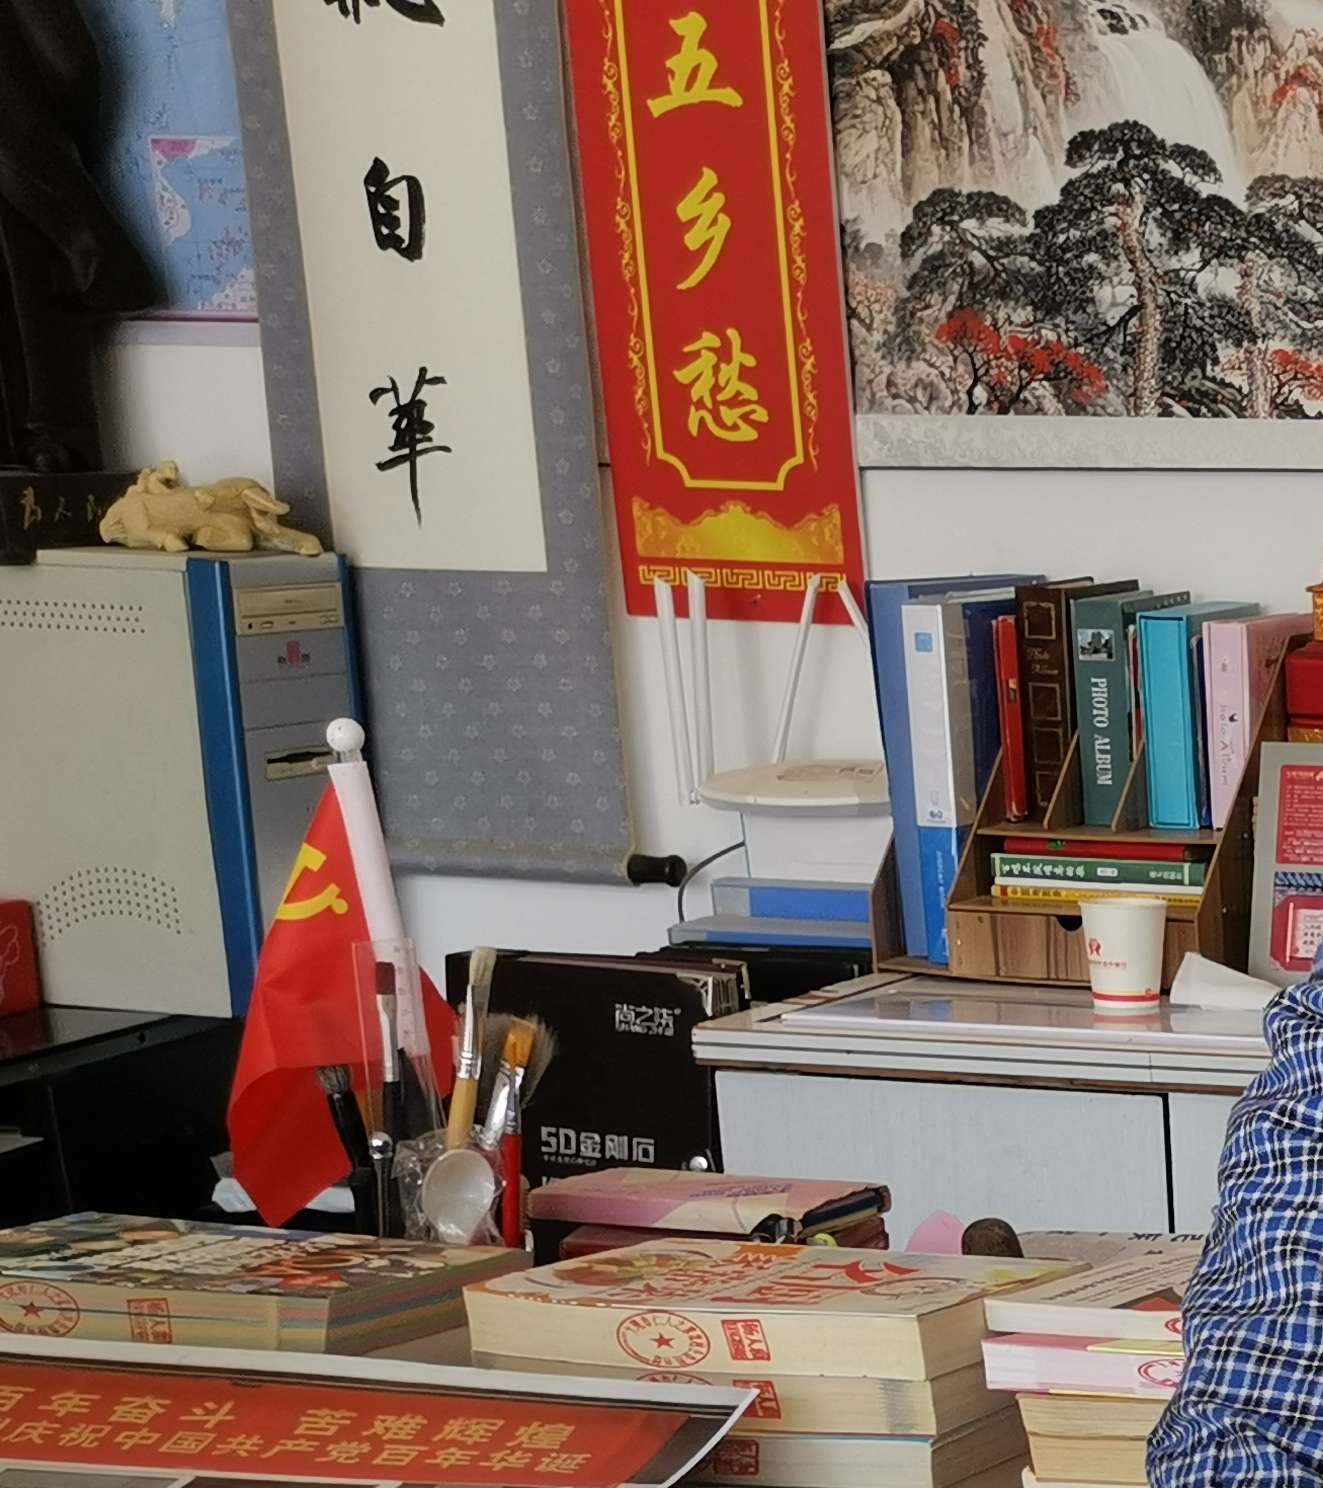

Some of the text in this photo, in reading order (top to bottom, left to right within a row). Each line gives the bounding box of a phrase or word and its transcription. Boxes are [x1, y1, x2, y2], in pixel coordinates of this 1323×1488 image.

[323, 0, 452, 527] 自華
[646, 10, 769, 446] 五乡愁
[1091, 677, 1114, 786] PHOTO ALBUM
[540, 1126, 655, 1164] 5D金刚石
[287, 1407, 578, 1452] 苦难辉煌
